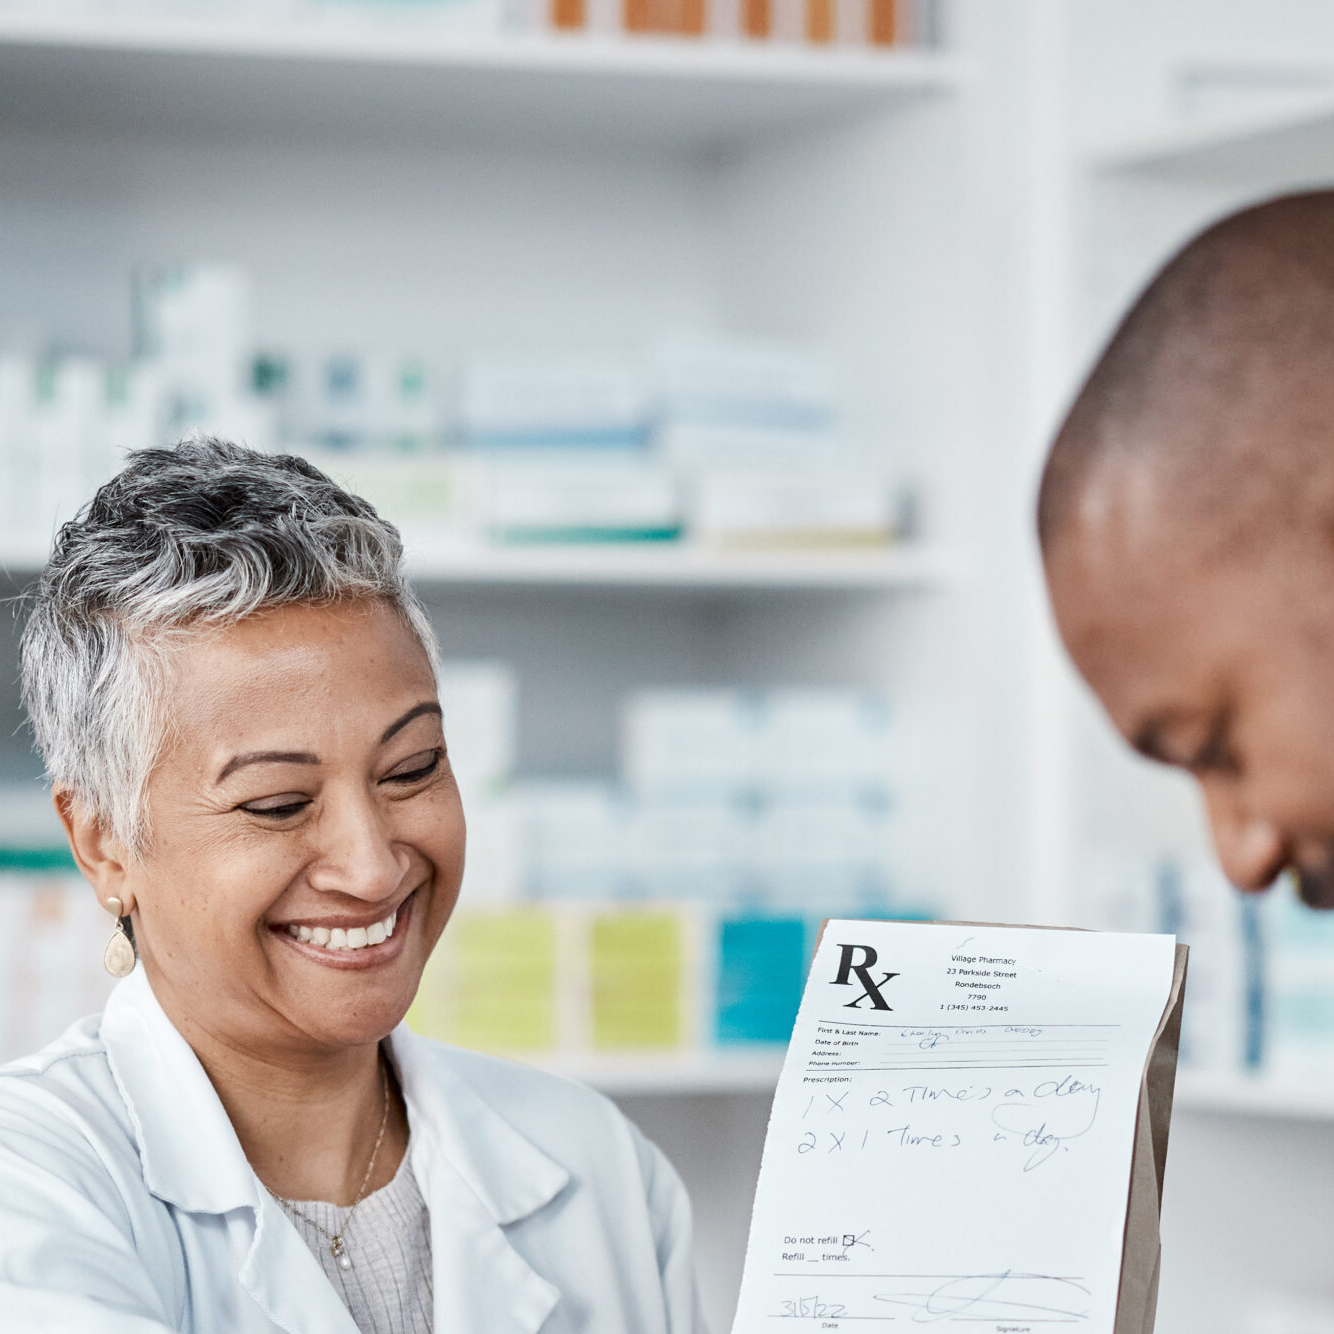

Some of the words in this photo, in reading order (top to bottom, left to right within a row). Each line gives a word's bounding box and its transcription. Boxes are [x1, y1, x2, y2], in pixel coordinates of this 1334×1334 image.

[951, 955, 976, 963] Village
[979, 956, 1016, 965] Pharmacy
[959, 968, 991, 977] Parkside
[993, 970, 1017, 978] Street
[955, 981, 1001, 990] Rondebsoch
[784, 1236, 797, 1244] Do
[799, 1236, 815, 1244] not
[817, 1236, 838, 1244] refill
[782, 1253, 805, 1261] Refill
[996, 1325, 1031, 1333] Signature
